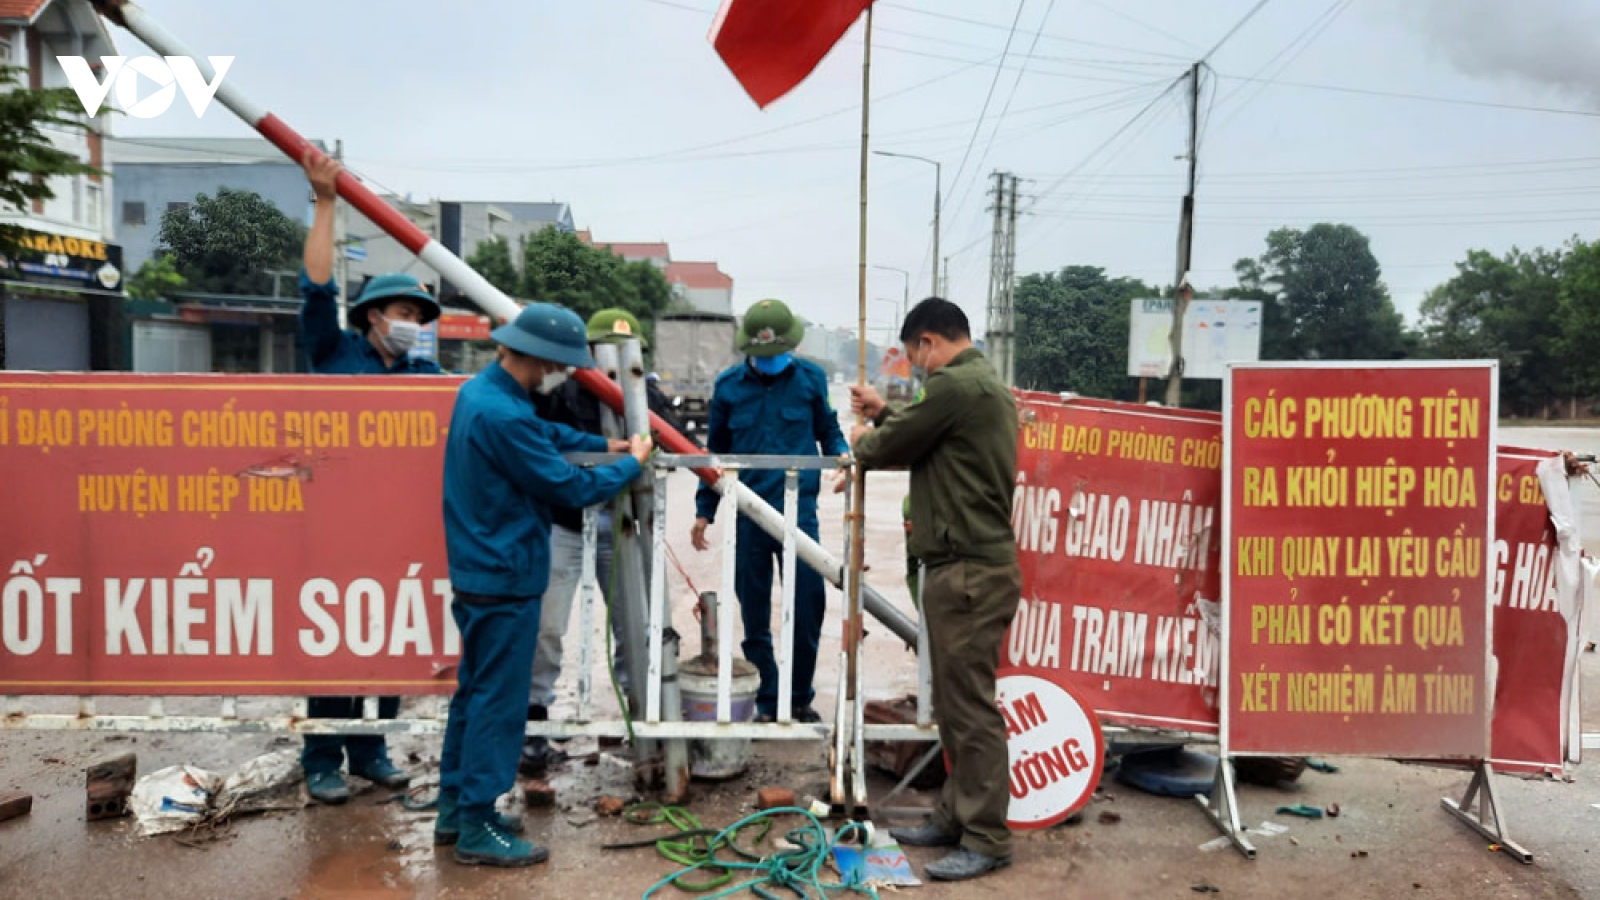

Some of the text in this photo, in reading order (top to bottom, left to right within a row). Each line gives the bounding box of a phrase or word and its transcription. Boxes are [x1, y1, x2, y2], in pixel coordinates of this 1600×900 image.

[17, 408, 72, 453] ĐẠO
[79, 402, 173, 447] PHÒNG
[182, 397, 277, 448] CHỐNG
[285, 410, 350, 454] DỊCH
[358, 410, 448, 447] COVID-
[1024, 412, 1057, 450] CHỈ
[1061, 423, 1101, 460] ĐẠO
[1106, 428, 1175, 464] PHÒNG
[1245, 389, 1479, 448] CÁC PHƯƠNG TIỆN
[78, 469, 168, 518] HUYỆN
[177, 468, 239, 519] HIỆP
[1243, 448, 1477, 516] RA KHỎI HIỆP HÒA
[1010, 470, 1213, 583] ÔNG GIAO NHẬN
[1238, 523, 1481, 586] KHI QUAY LẠI YÊU CẦU
[2, 547, 461, 656] ỐT KIỂM SOÁT
[1252, 588, 1464, 650] PHẢI CÓ KẾT QUẢ
[1070, 605, 1147, 690] TRẠM
[998, 691, 1048, 740] ẤM
[1241, 663, 1475, 722] XÉT NGHIỆM ÂM TÍNH
[1010, 738, 1089, 799] ƯỜNG
